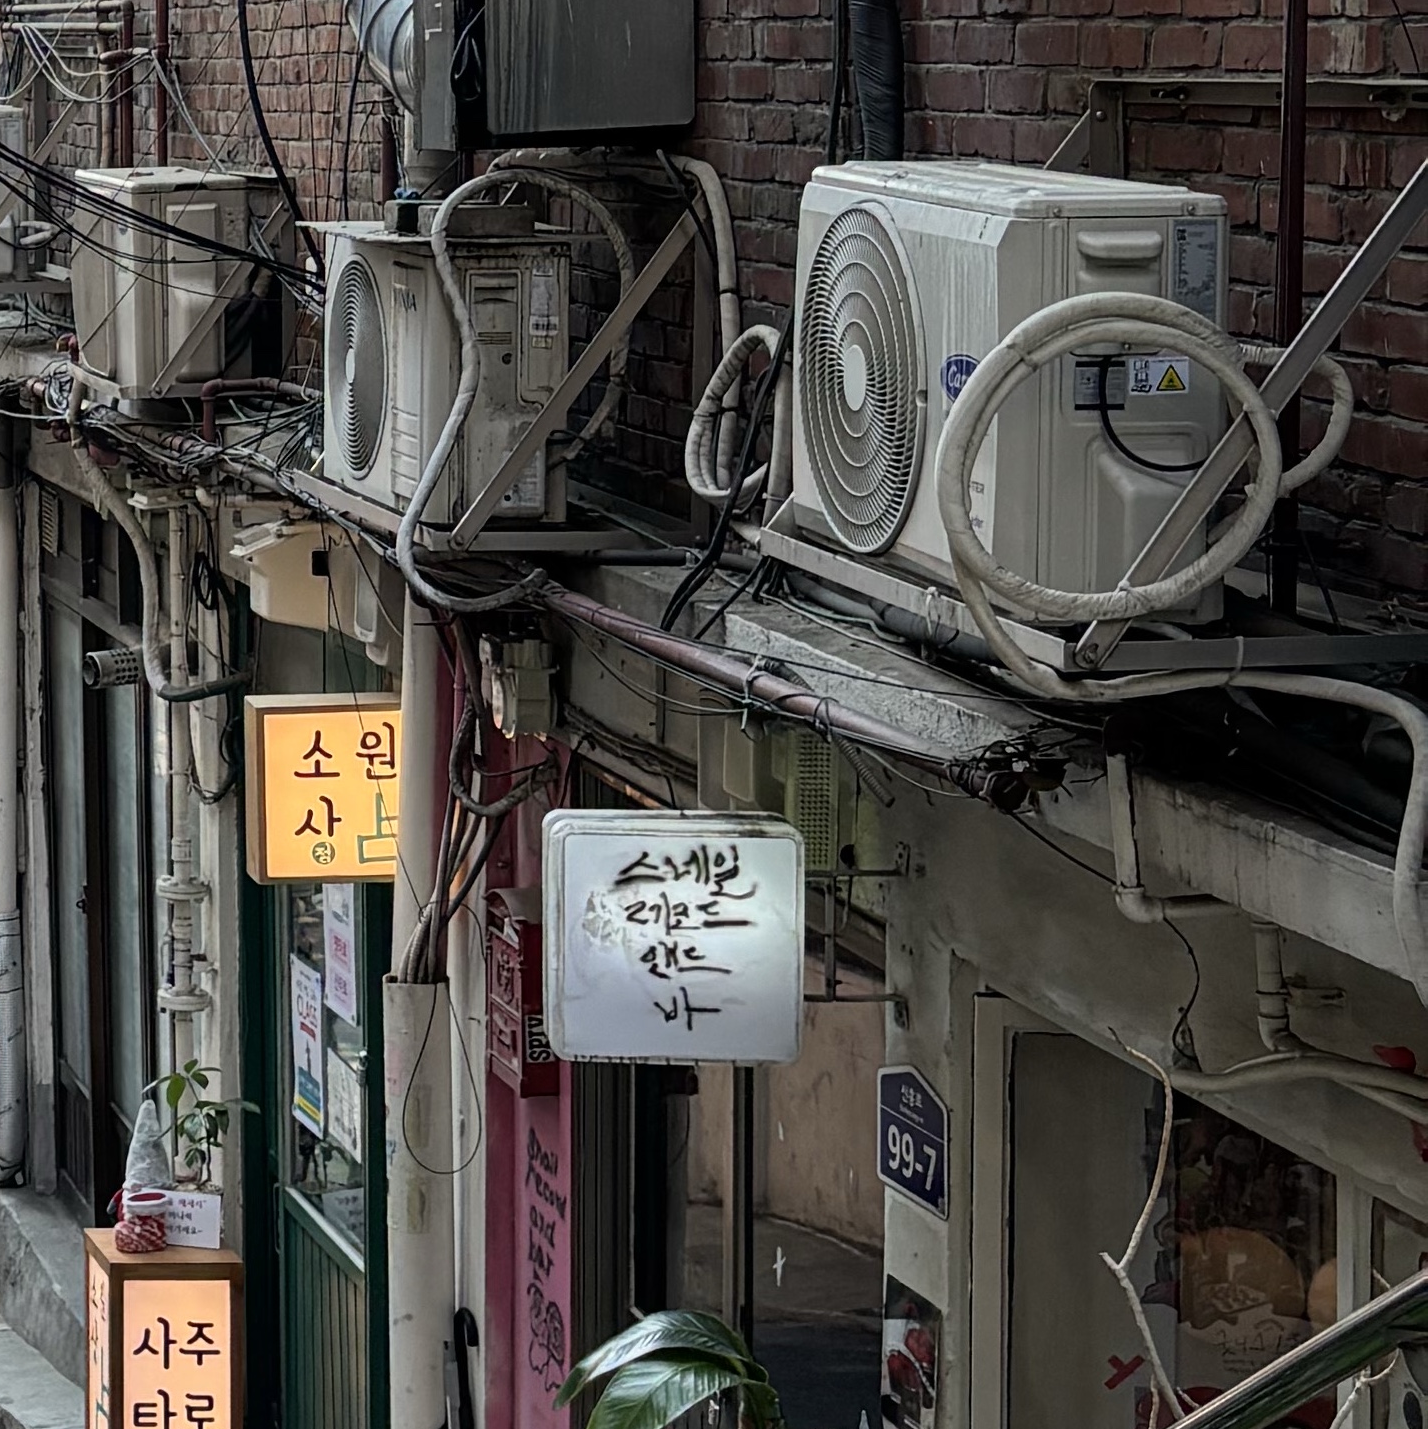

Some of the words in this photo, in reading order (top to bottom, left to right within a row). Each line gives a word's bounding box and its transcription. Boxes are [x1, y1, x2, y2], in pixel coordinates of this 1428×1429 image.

[294, 722, 397, 780] 소원
[614, 845, 757, 900] 스네일
[653, 986, 722, 1031] 바
[887, 1124, 937, 1191] 99-7
[133, 1317, 221, 1370] 사주
